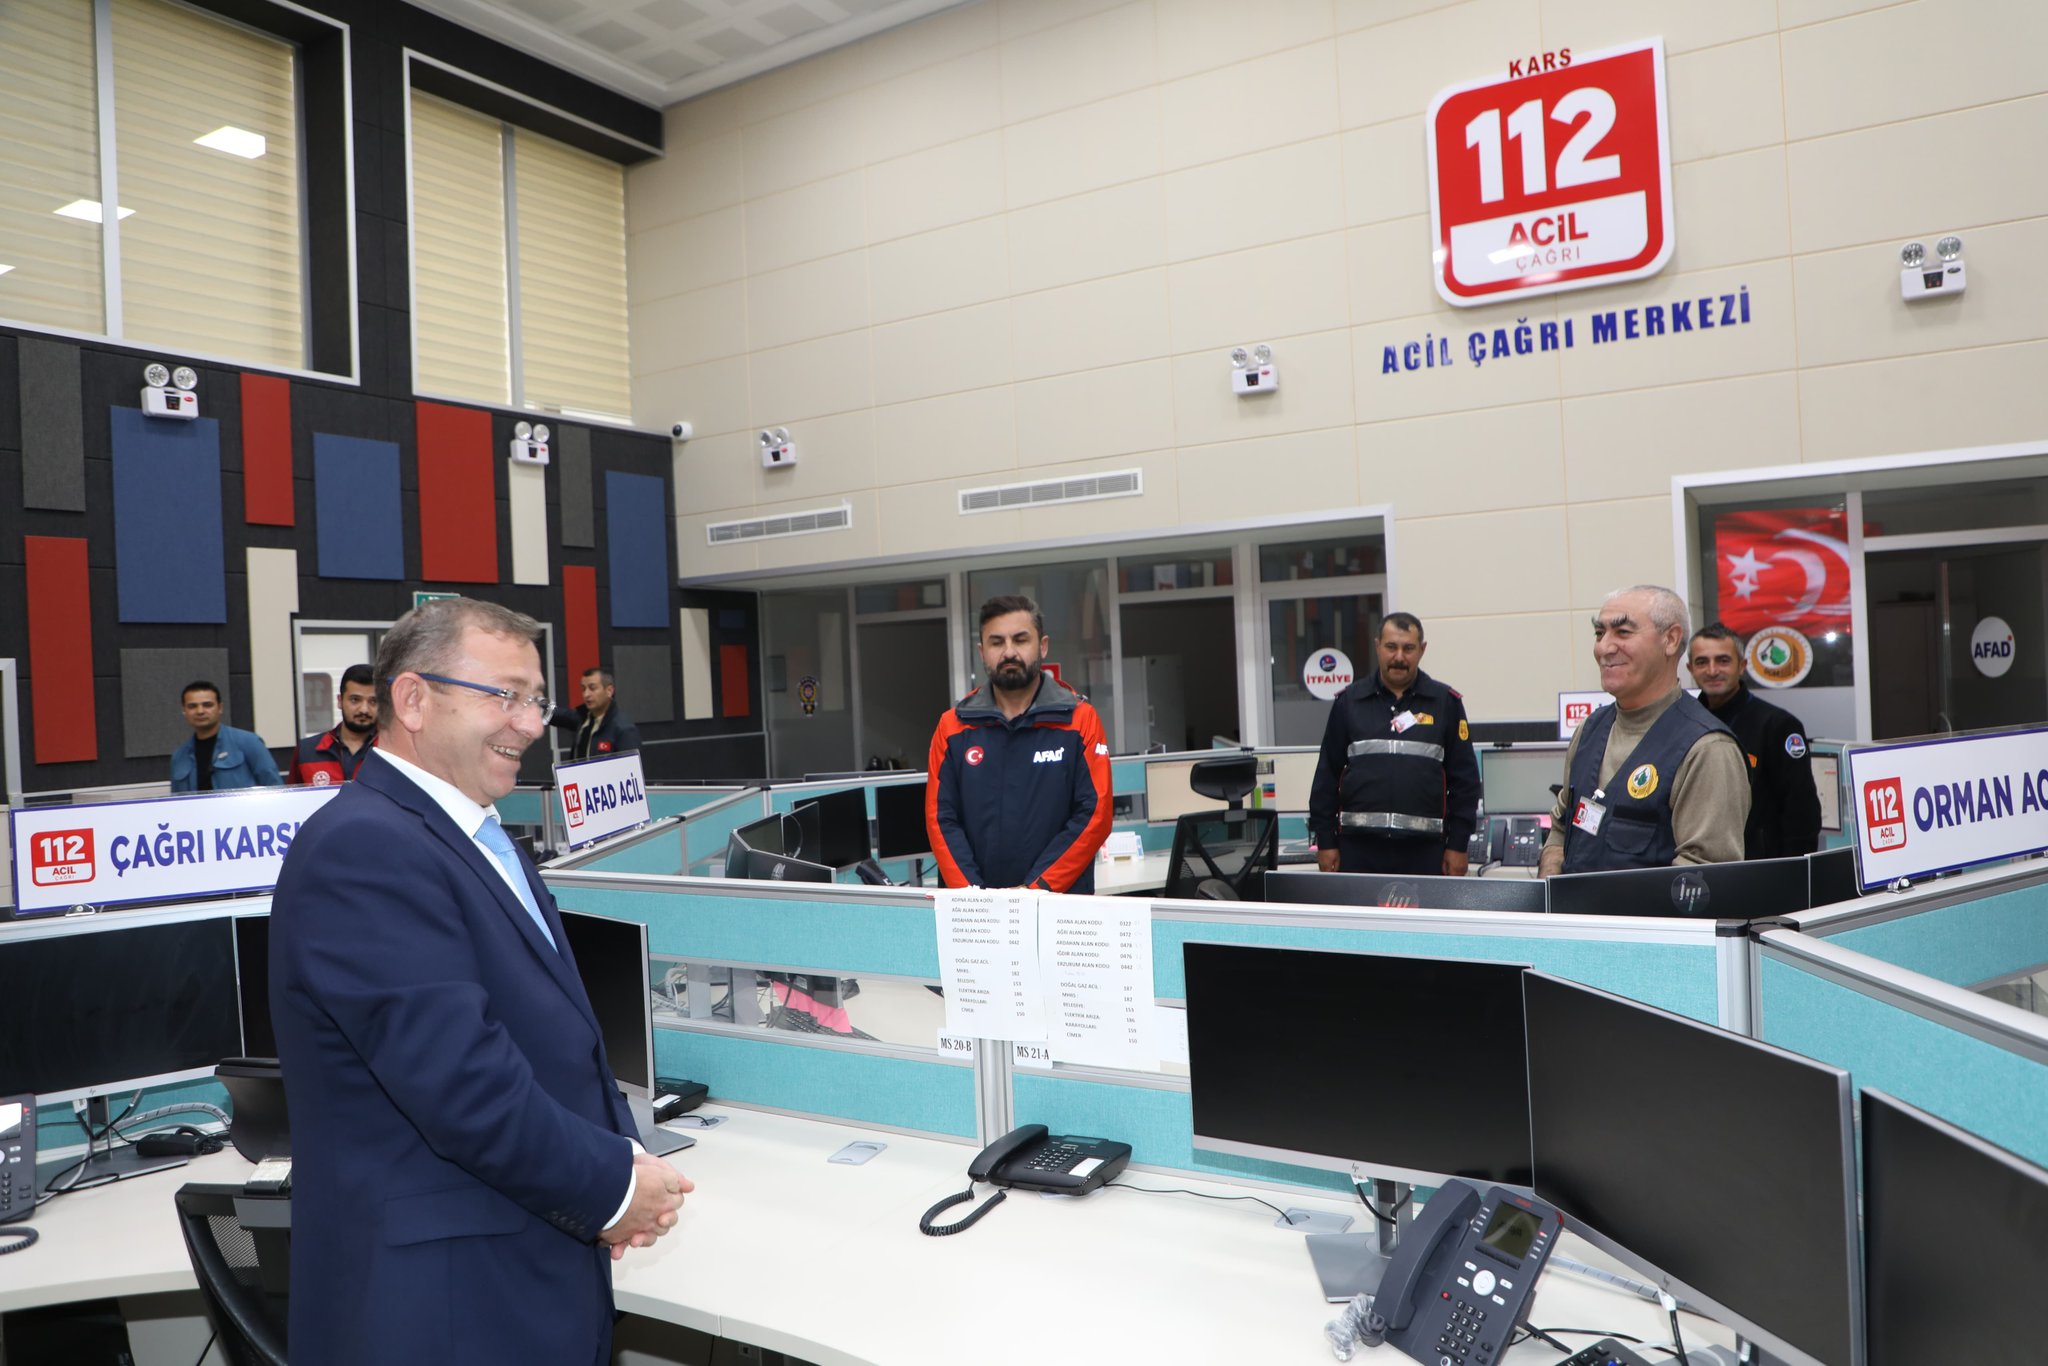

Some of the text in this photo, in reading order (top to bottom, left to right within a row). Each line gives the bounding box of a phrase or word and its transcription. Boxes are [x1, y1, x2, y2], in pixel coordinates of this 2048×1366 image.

[1508, 48, 1572, 78] KARS
[1465, 86, 1622, 205] 112
[1381, 285, 1751, 375] ACİL ÇAĞRI MERKEZİ
[1974, 640, 2011, 659] AFAD
[1569, 704, 1587, 719] 112
[1033, 748, 1064, 763] AFAD
[565, 788, 579, 810] 112
[585, 772, 643, 816] AFAD ACİL
[1869, 785, 1899, 821] 112
[1913, 775, 2014, 832] ORMAN
[40, 835, 85, 863] 112
[110, 822, 205, 878] ÇAĞRI
[940, 1037, 972, 1051] MS 20-B
[1016, 1046, 1050, 1060] MS 21-A
